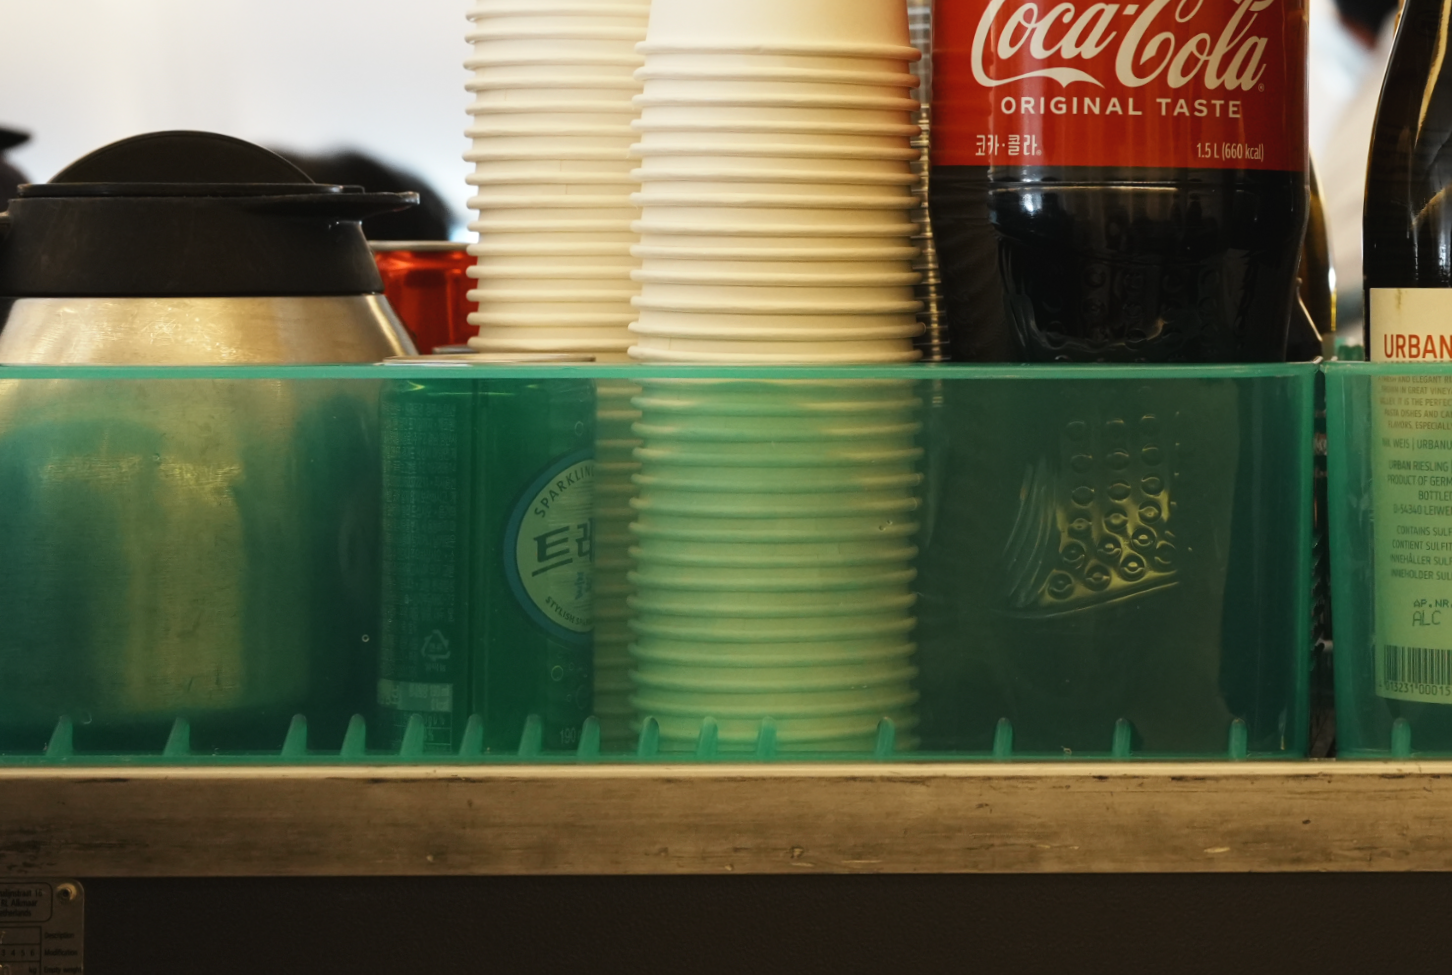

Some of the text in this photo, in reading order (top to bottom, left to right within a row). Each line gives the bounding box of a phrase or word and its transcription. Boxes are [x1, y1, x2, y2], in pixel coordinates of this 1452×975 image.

[1000, 97, 1241, 118] ORIGINAL TASTE
[1196, 143, 1264, 161] 1.5 L (660 kcal)
[1408, 387, 1427, 395] GREAT
[1424, 410, 1438, 418] AND
[1413, 460, 1449, 471] RIESLING
[1418, 476, 1427, 485] OF
[1412, 611, 1440, 627] ALC
